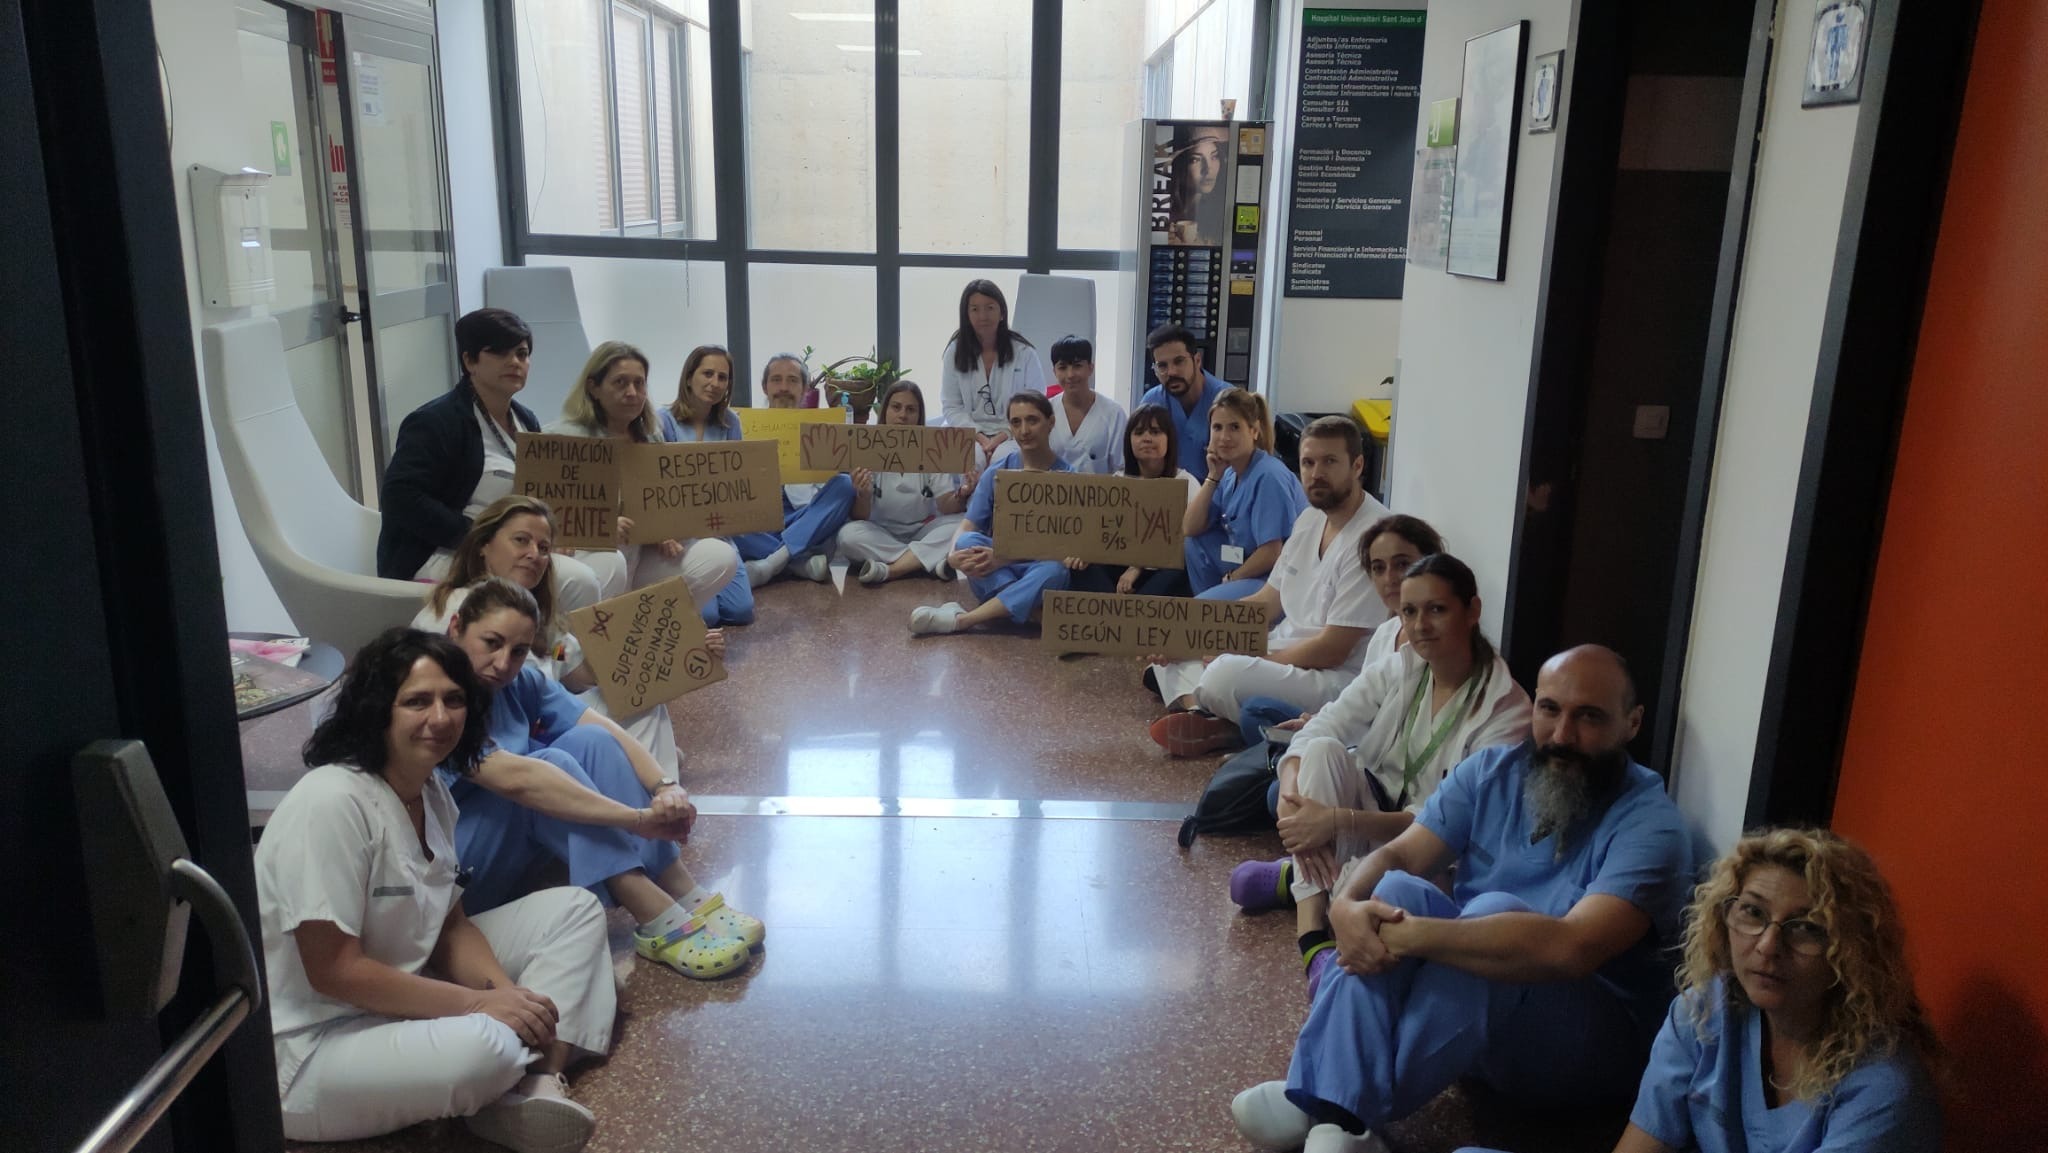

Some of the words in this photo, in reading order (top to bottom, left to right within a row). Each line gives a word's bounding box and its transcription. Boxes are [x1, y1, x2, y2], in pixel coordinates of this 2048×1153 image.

[1312, 14, 1339, 23] Hospital
[1152, 138, 1174, 232] BREAK
[524, 440, 613, 464] AMPLIACIÓN
[658, 450, 742, 479] RESPETO
[561, 464, 580, 480] DE
[524, 482, 606, 501] PLANTILLA
[642, 478, 757, 510] PROFESIONAL
[1007, 482, 1132, 508] COORDINADOR
[1010, 510, 1082, 535] TÉCNICO
[1052, 596, 1188, 621] RECONVERSIÓN
[1202, 604, 1266, 625] PLAZAS
[612, 592, 655, 686] SUPERVISOR
[656, 620, 682, 682] TÉCNICO
[1058, 621, 1122, 643] SEGÚN
[1136, 628, 1170, 647] LEY
[1186, 630, 1260, 652] VIGENTE
[631, 597, 678, 707] COORDINADOR
